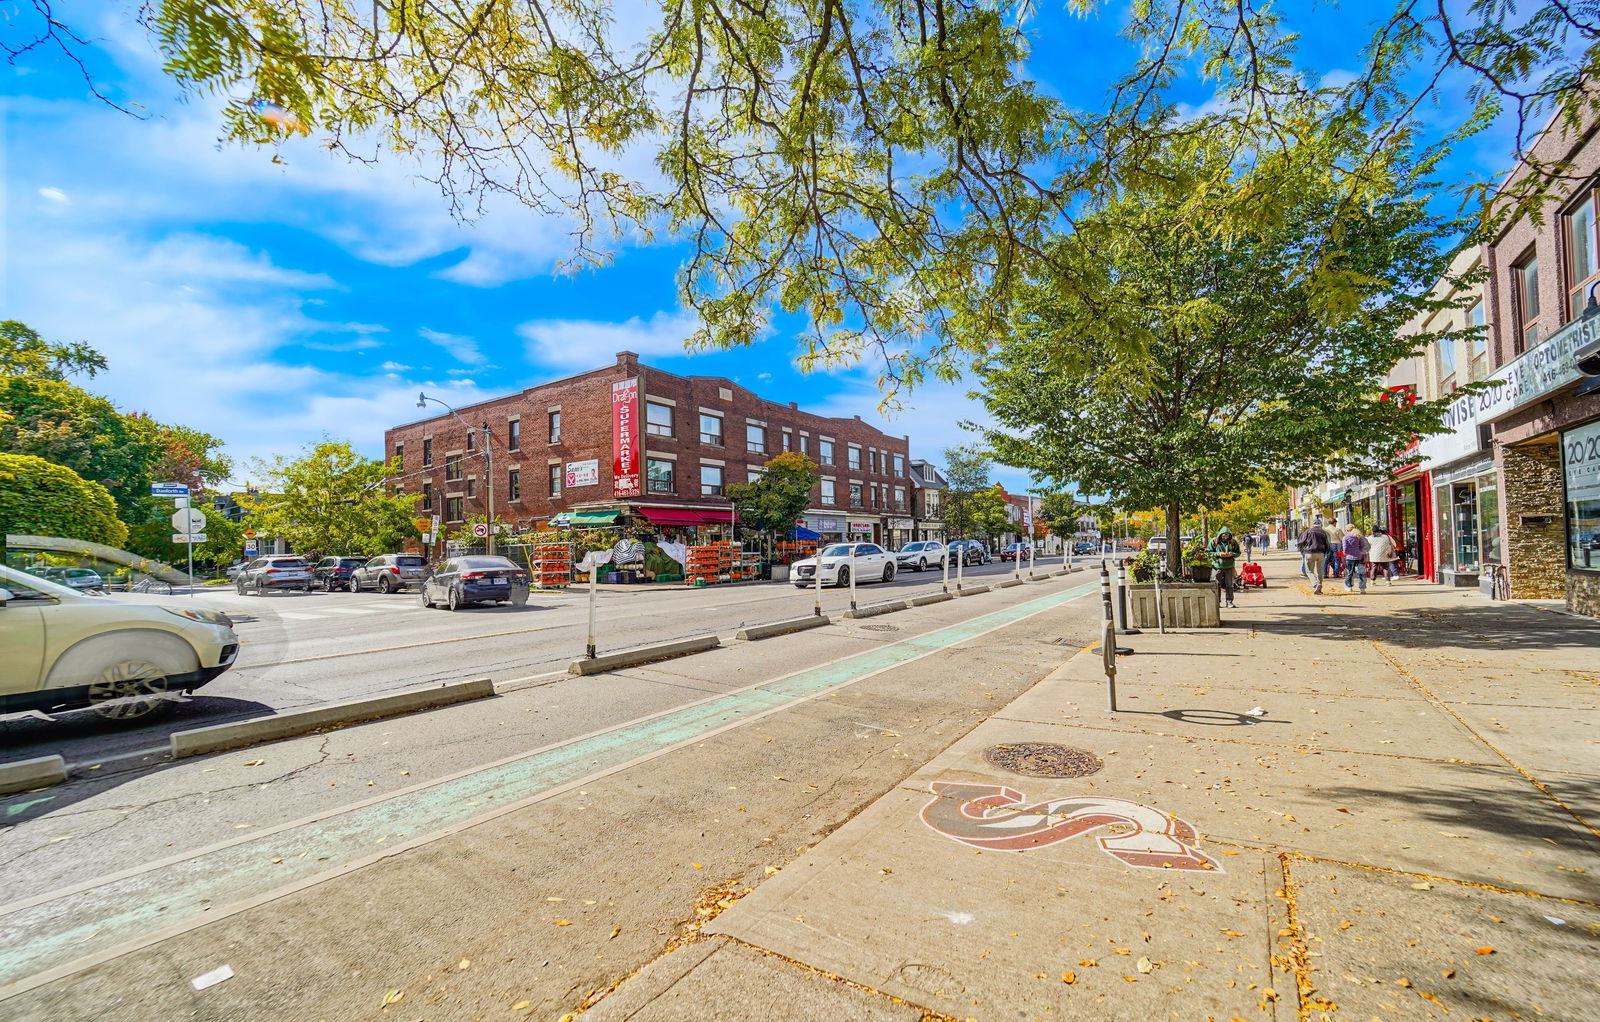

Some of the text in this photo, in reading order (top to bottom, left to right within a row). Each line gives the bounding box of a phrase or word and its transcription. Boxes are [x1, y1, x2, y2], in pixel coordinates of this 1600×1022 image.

[1534, 320, 1596, 369] OPTOMETRIST
[1508, 365, 1524, 385] EYE
[613, 388, 638, 404] Dragon
[1506, 381, 1529, 401] CARE
[619, 405, 631, 474] SUPERMARKET
[1568, 468, 1582, 477] EYE
